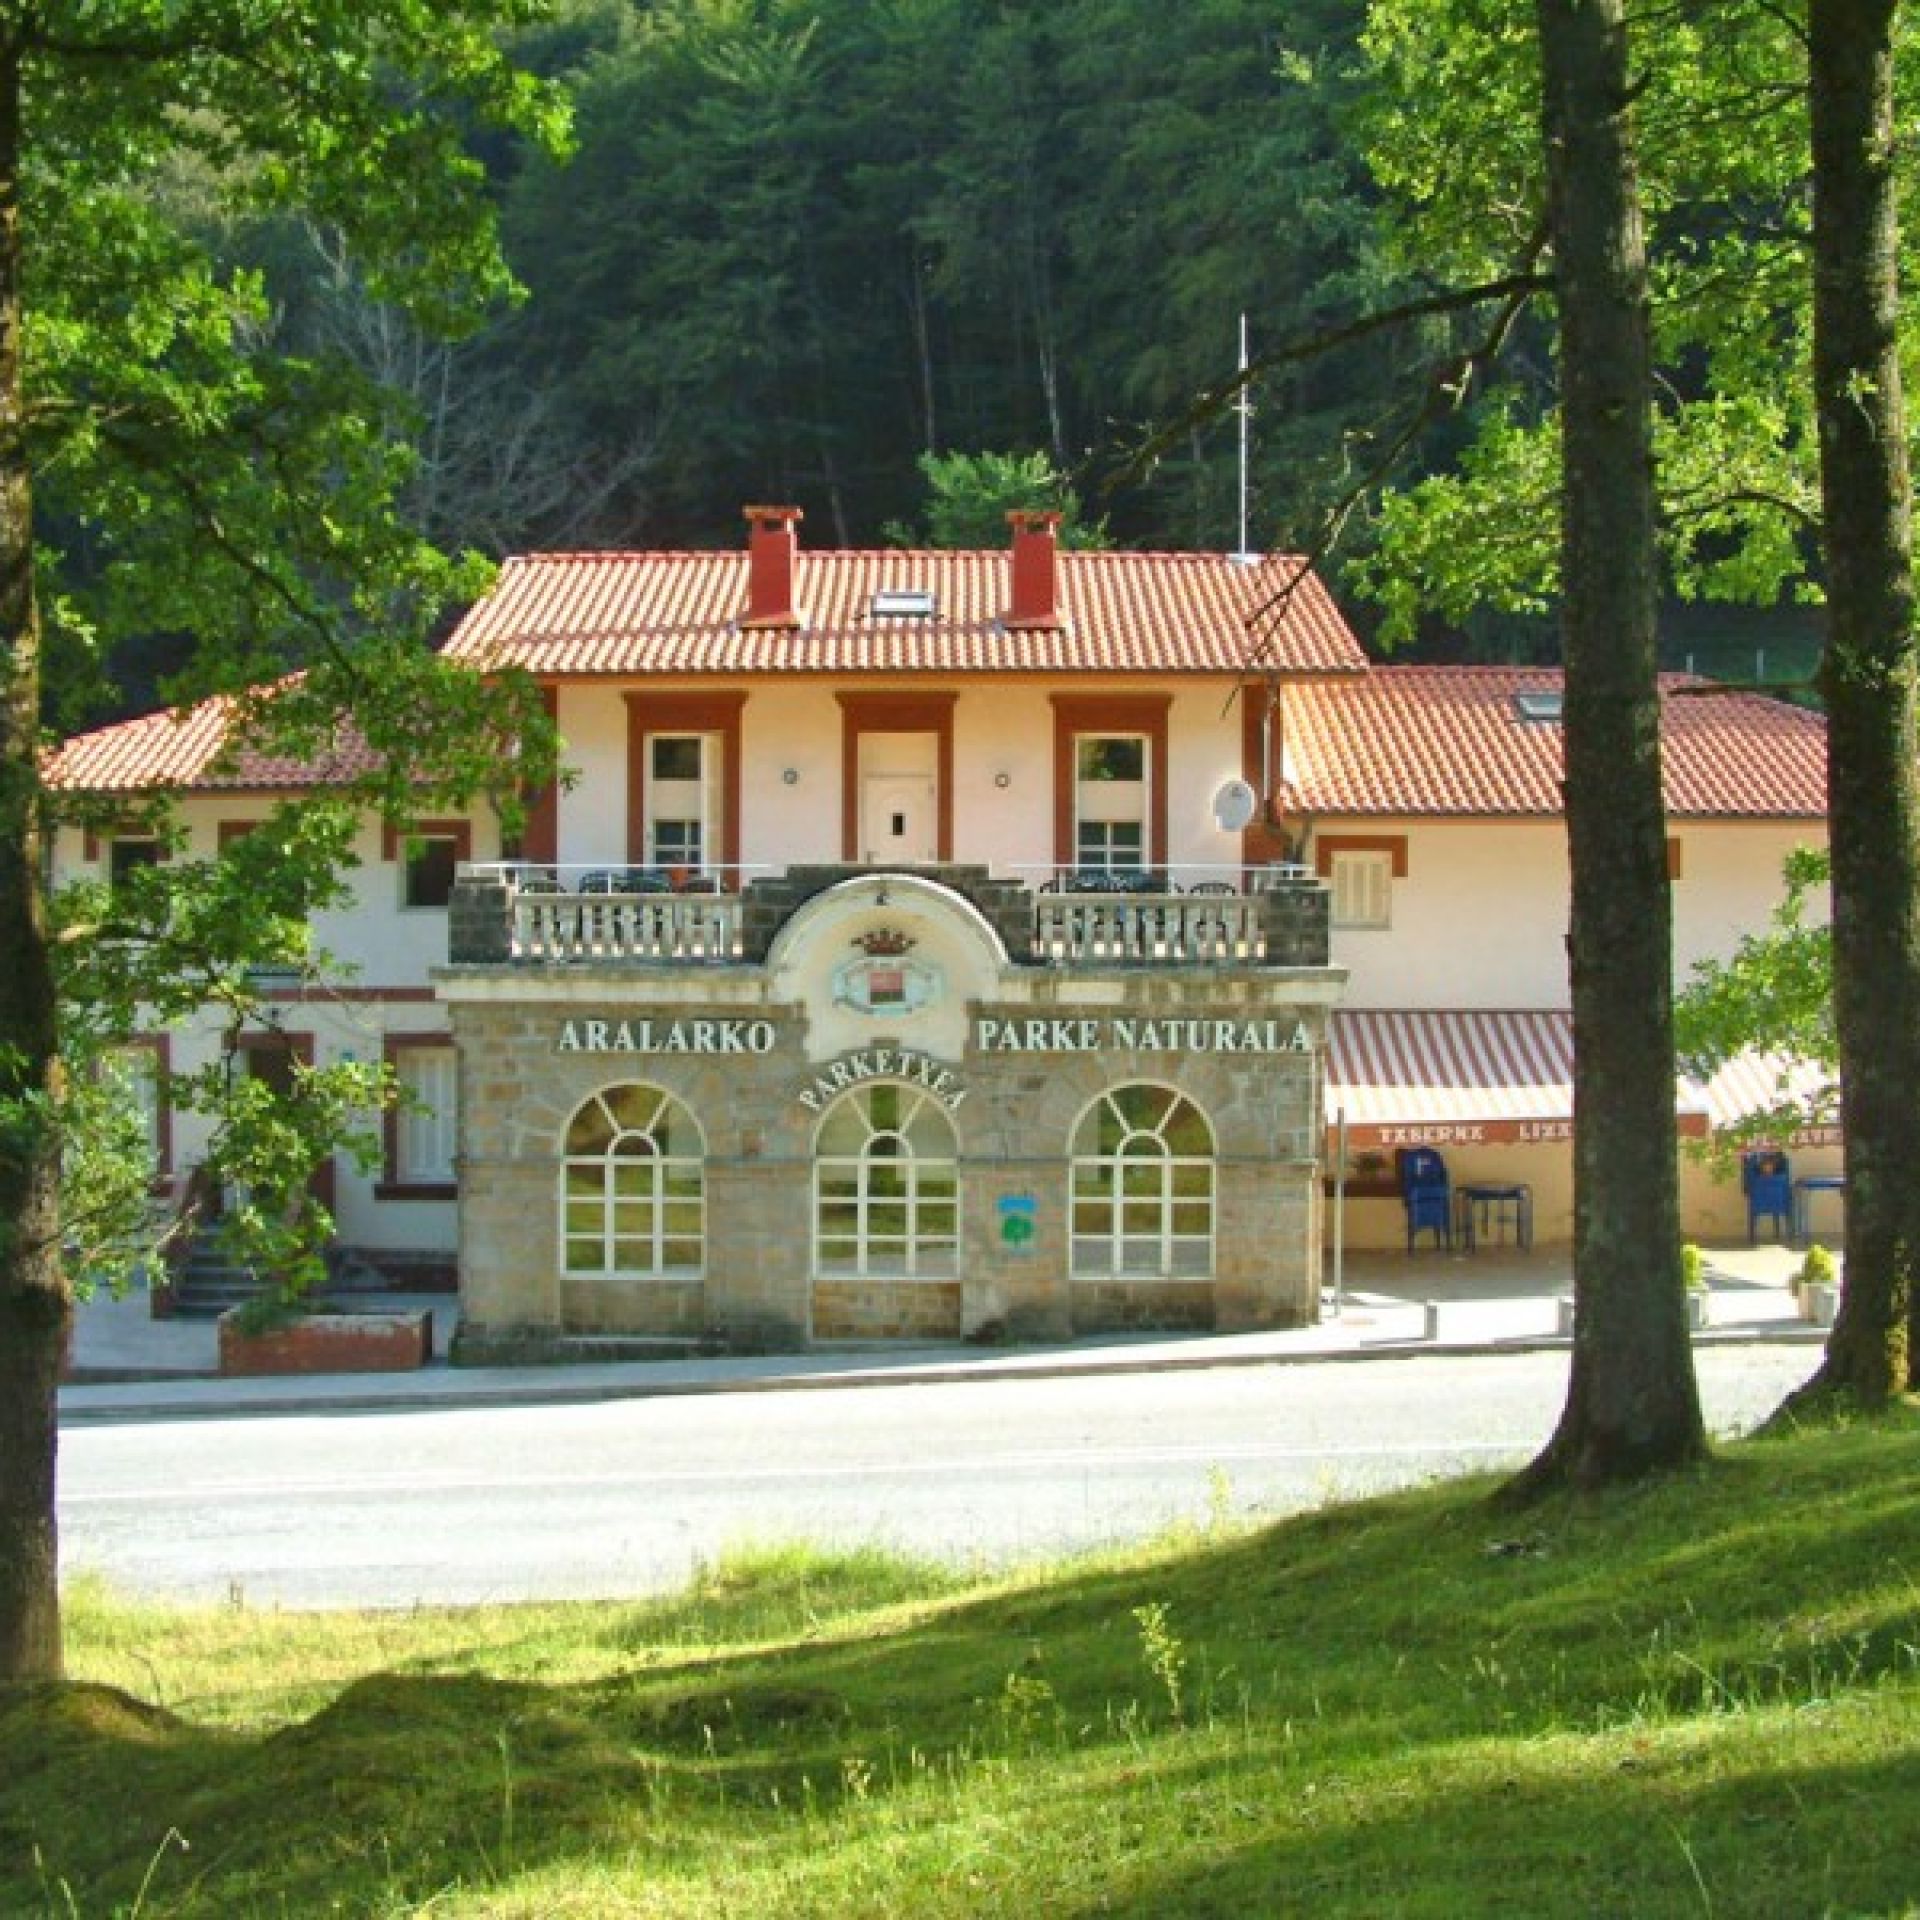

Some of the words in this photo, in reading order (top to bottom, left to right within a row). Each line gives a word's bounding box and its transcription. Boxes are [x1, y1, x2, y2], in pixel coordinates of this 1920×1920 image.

[559, 1020, 776, 1053] ARALARKO
[978, 1020, 1100, 1051] PARKE
[1113, 1020, 1313, 1052] NATURALA
[799, 1049, 967, 1111] PARKETXEA
